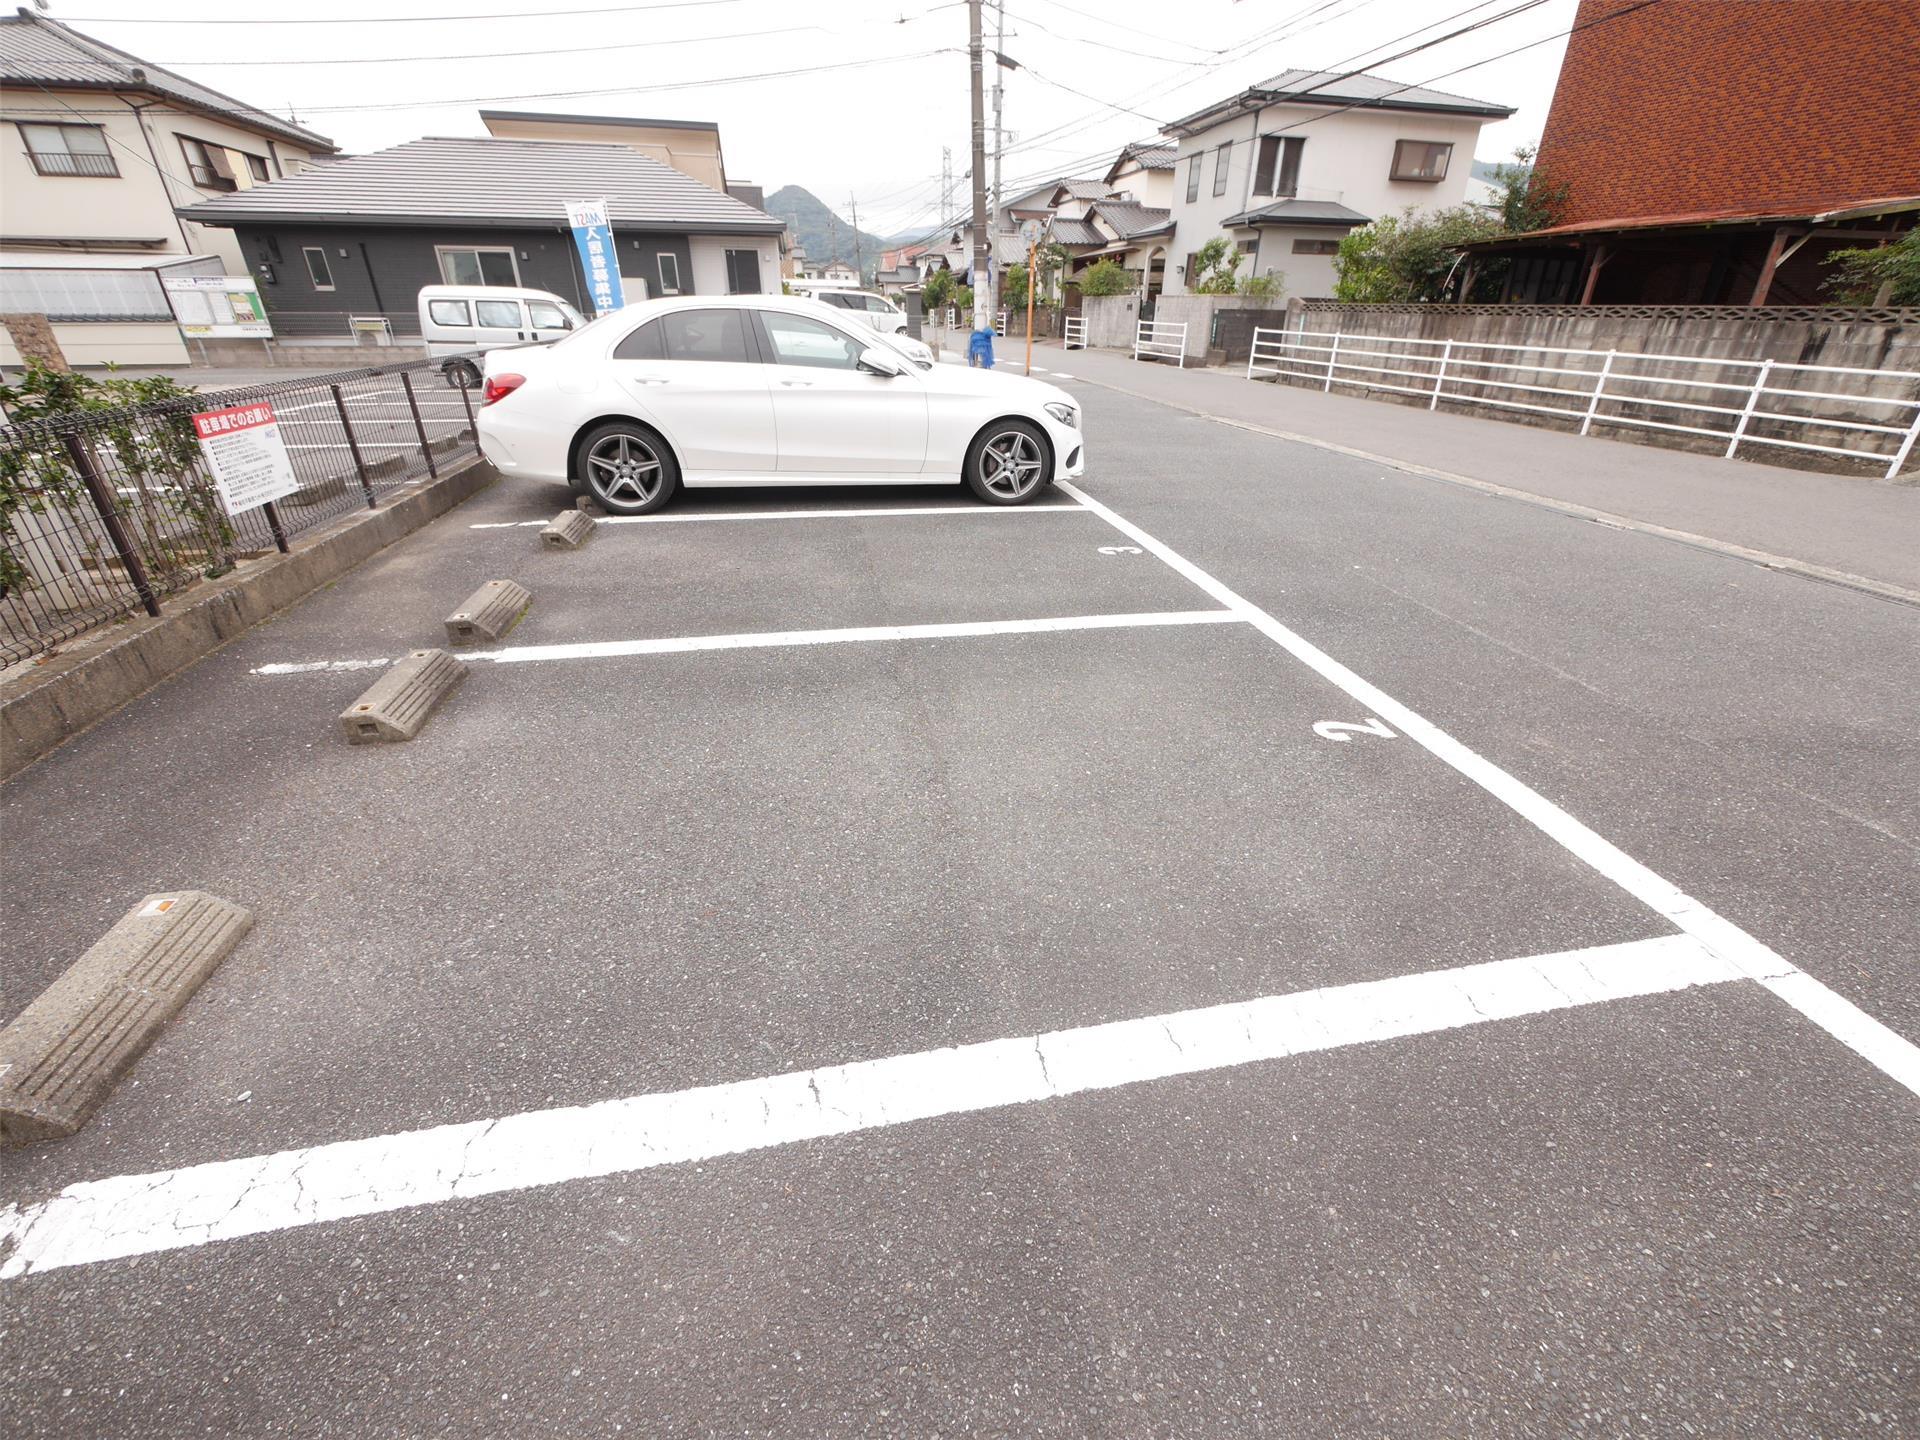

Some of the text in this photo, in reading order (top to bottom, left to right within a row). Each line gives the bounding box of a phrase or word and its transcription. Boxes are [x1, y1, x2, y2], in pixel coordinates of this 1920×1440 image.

[199, 407, 272, 434] 駐車場でのお願い
[1097, 546, 1143, 555] 3
[1311, 718, 1398, 741] 2
